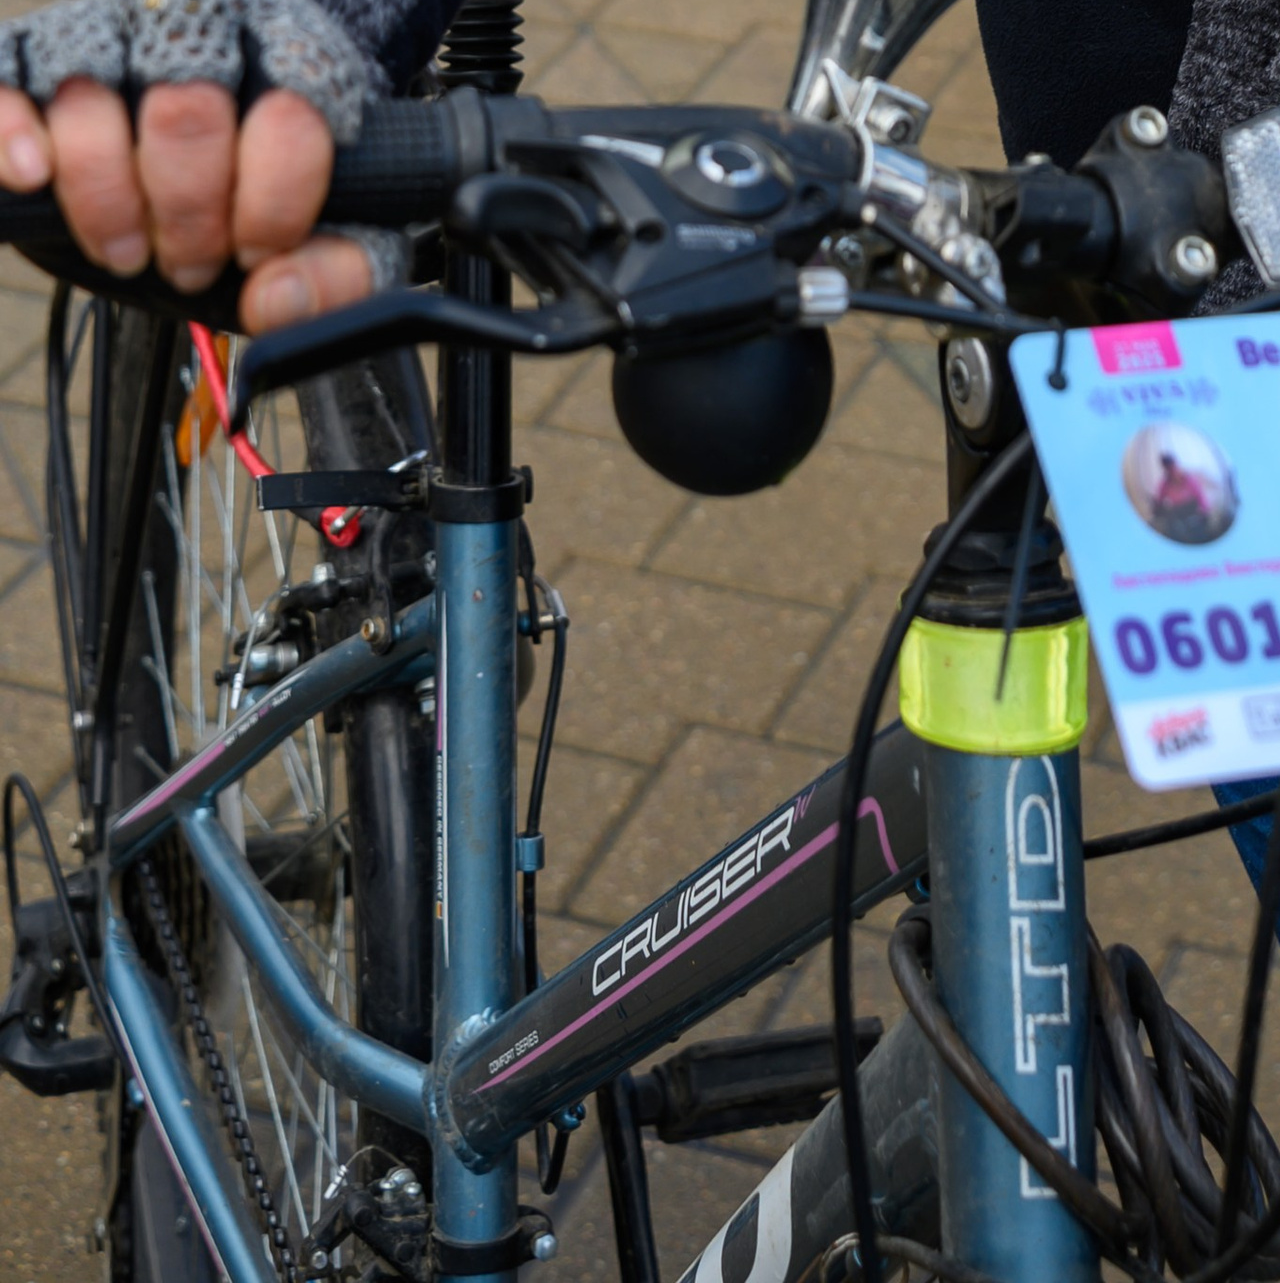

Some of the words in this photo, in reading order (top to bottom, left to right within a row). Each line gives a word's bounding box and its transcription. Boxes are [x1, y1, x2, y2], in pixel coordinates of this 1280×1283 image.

[592, 806, 795, 996] CRUISER
[489, 1047, 515, 1074] COMFORT
[514, 1030, 539, 1057] SERIES
